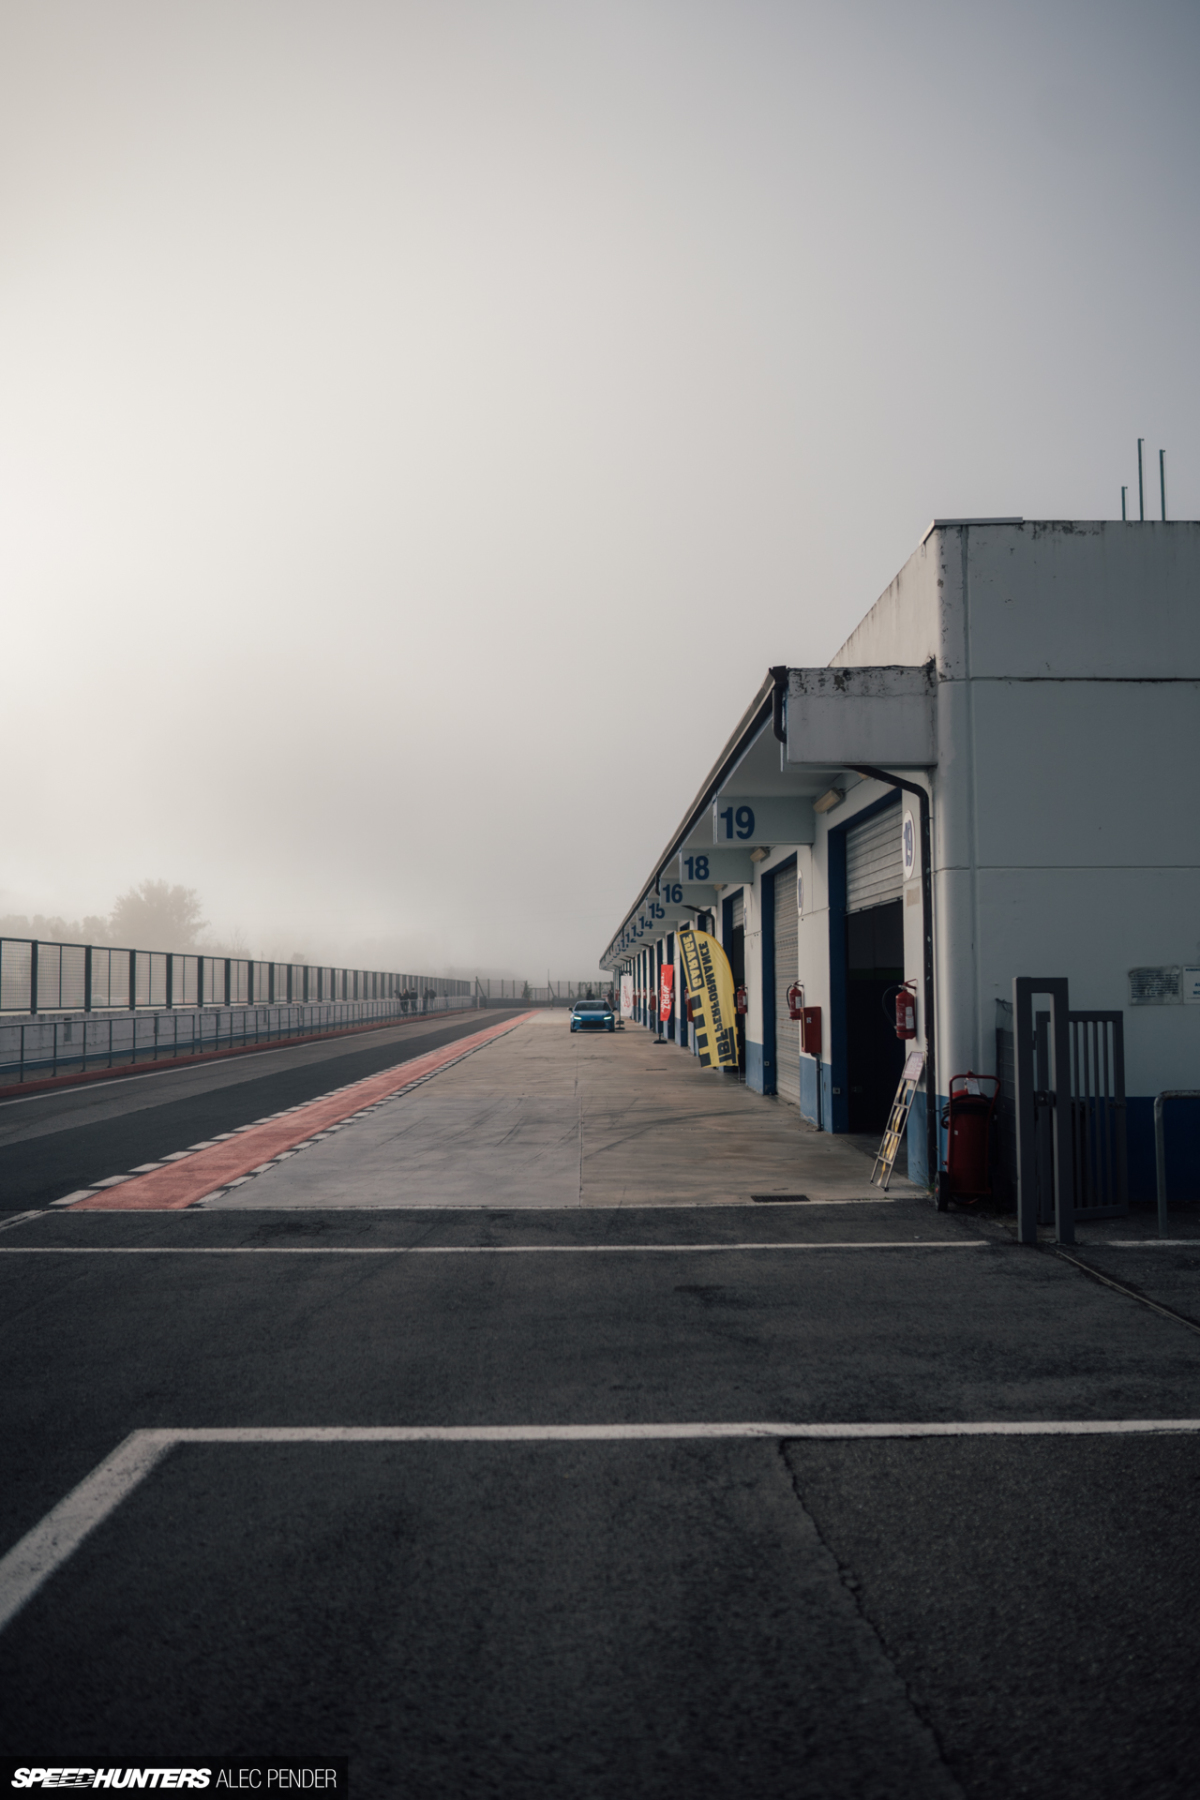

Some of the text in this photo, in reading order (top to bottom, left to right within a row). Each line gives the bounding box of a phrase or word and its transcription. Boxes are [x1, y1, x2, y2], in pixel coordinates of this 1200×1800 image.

[720, 805, 755, 840] 19
[903, 819, 912, 867] 19
[684, 855, 710, 880] 18
[662, 883, 683, 904] 16
[638, 915, 654, 930] 14
[648, 903, 666, 919] 15
